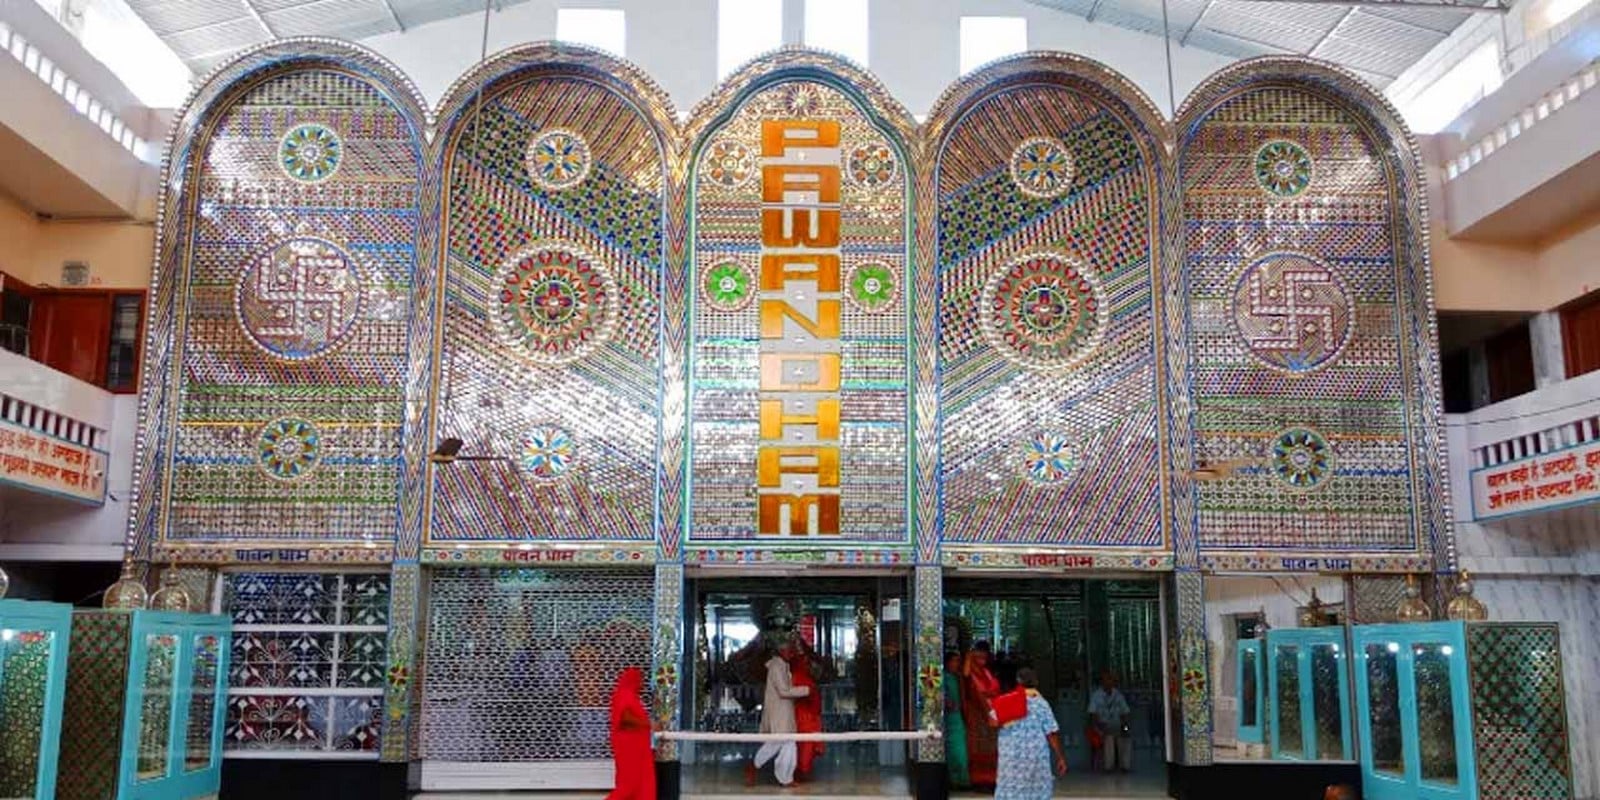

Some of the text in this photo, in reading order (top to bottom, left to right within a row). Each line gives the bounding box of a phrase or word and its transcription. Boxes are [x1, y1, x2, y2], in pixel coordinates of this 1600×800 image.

[235, 548, 309, 561] पावन धाम
[502, 549, 576, 562] पावन धाम
[1021, 554, 1093, 568] पावन धाम
[1280, 557, 1352, 571] पावन धाम
